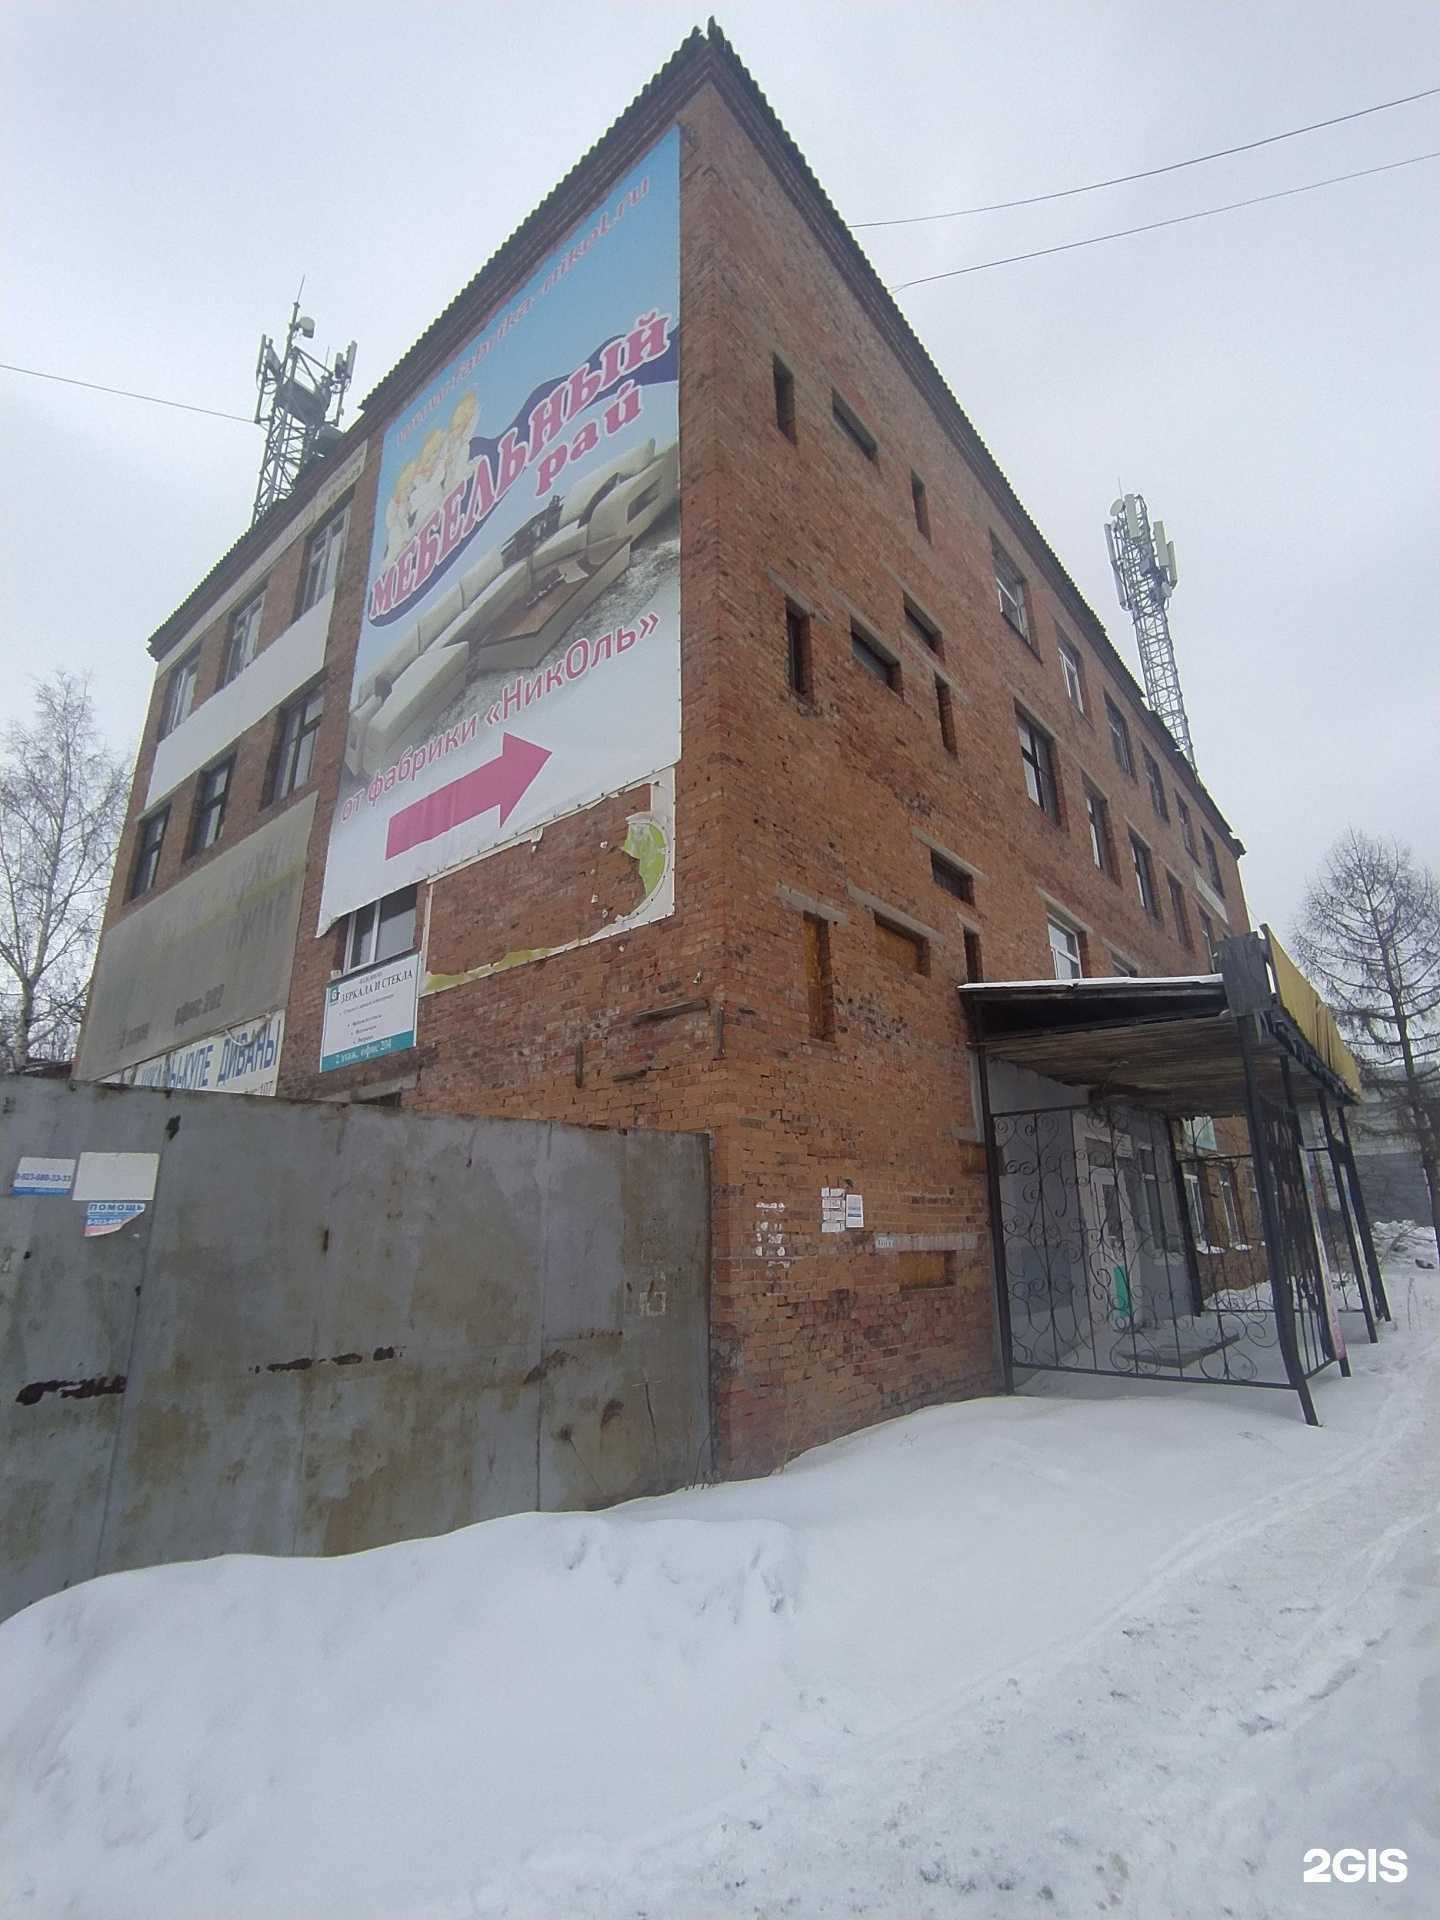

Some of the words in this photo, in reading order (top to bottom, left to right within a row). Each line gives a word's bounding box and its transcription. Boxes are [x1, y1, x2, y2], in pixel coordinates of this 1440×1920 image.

[369, 309, 672, 620] МЕБЕЛЬНЫЙ
[536, 383, 644, 497] рай
[339, 796, 364, 824] от
[367, 714, 478, 809] фабрики
[485, 611, 661, 726] «НикОль»
[341, 984, 373, 1002] ЗЕРКАЛА
[374, 981, 380, 992] И
[382, 969, 412, 987] СТЕКЛА
[216, 1019, 281, 1087] ДИВАНЫ
